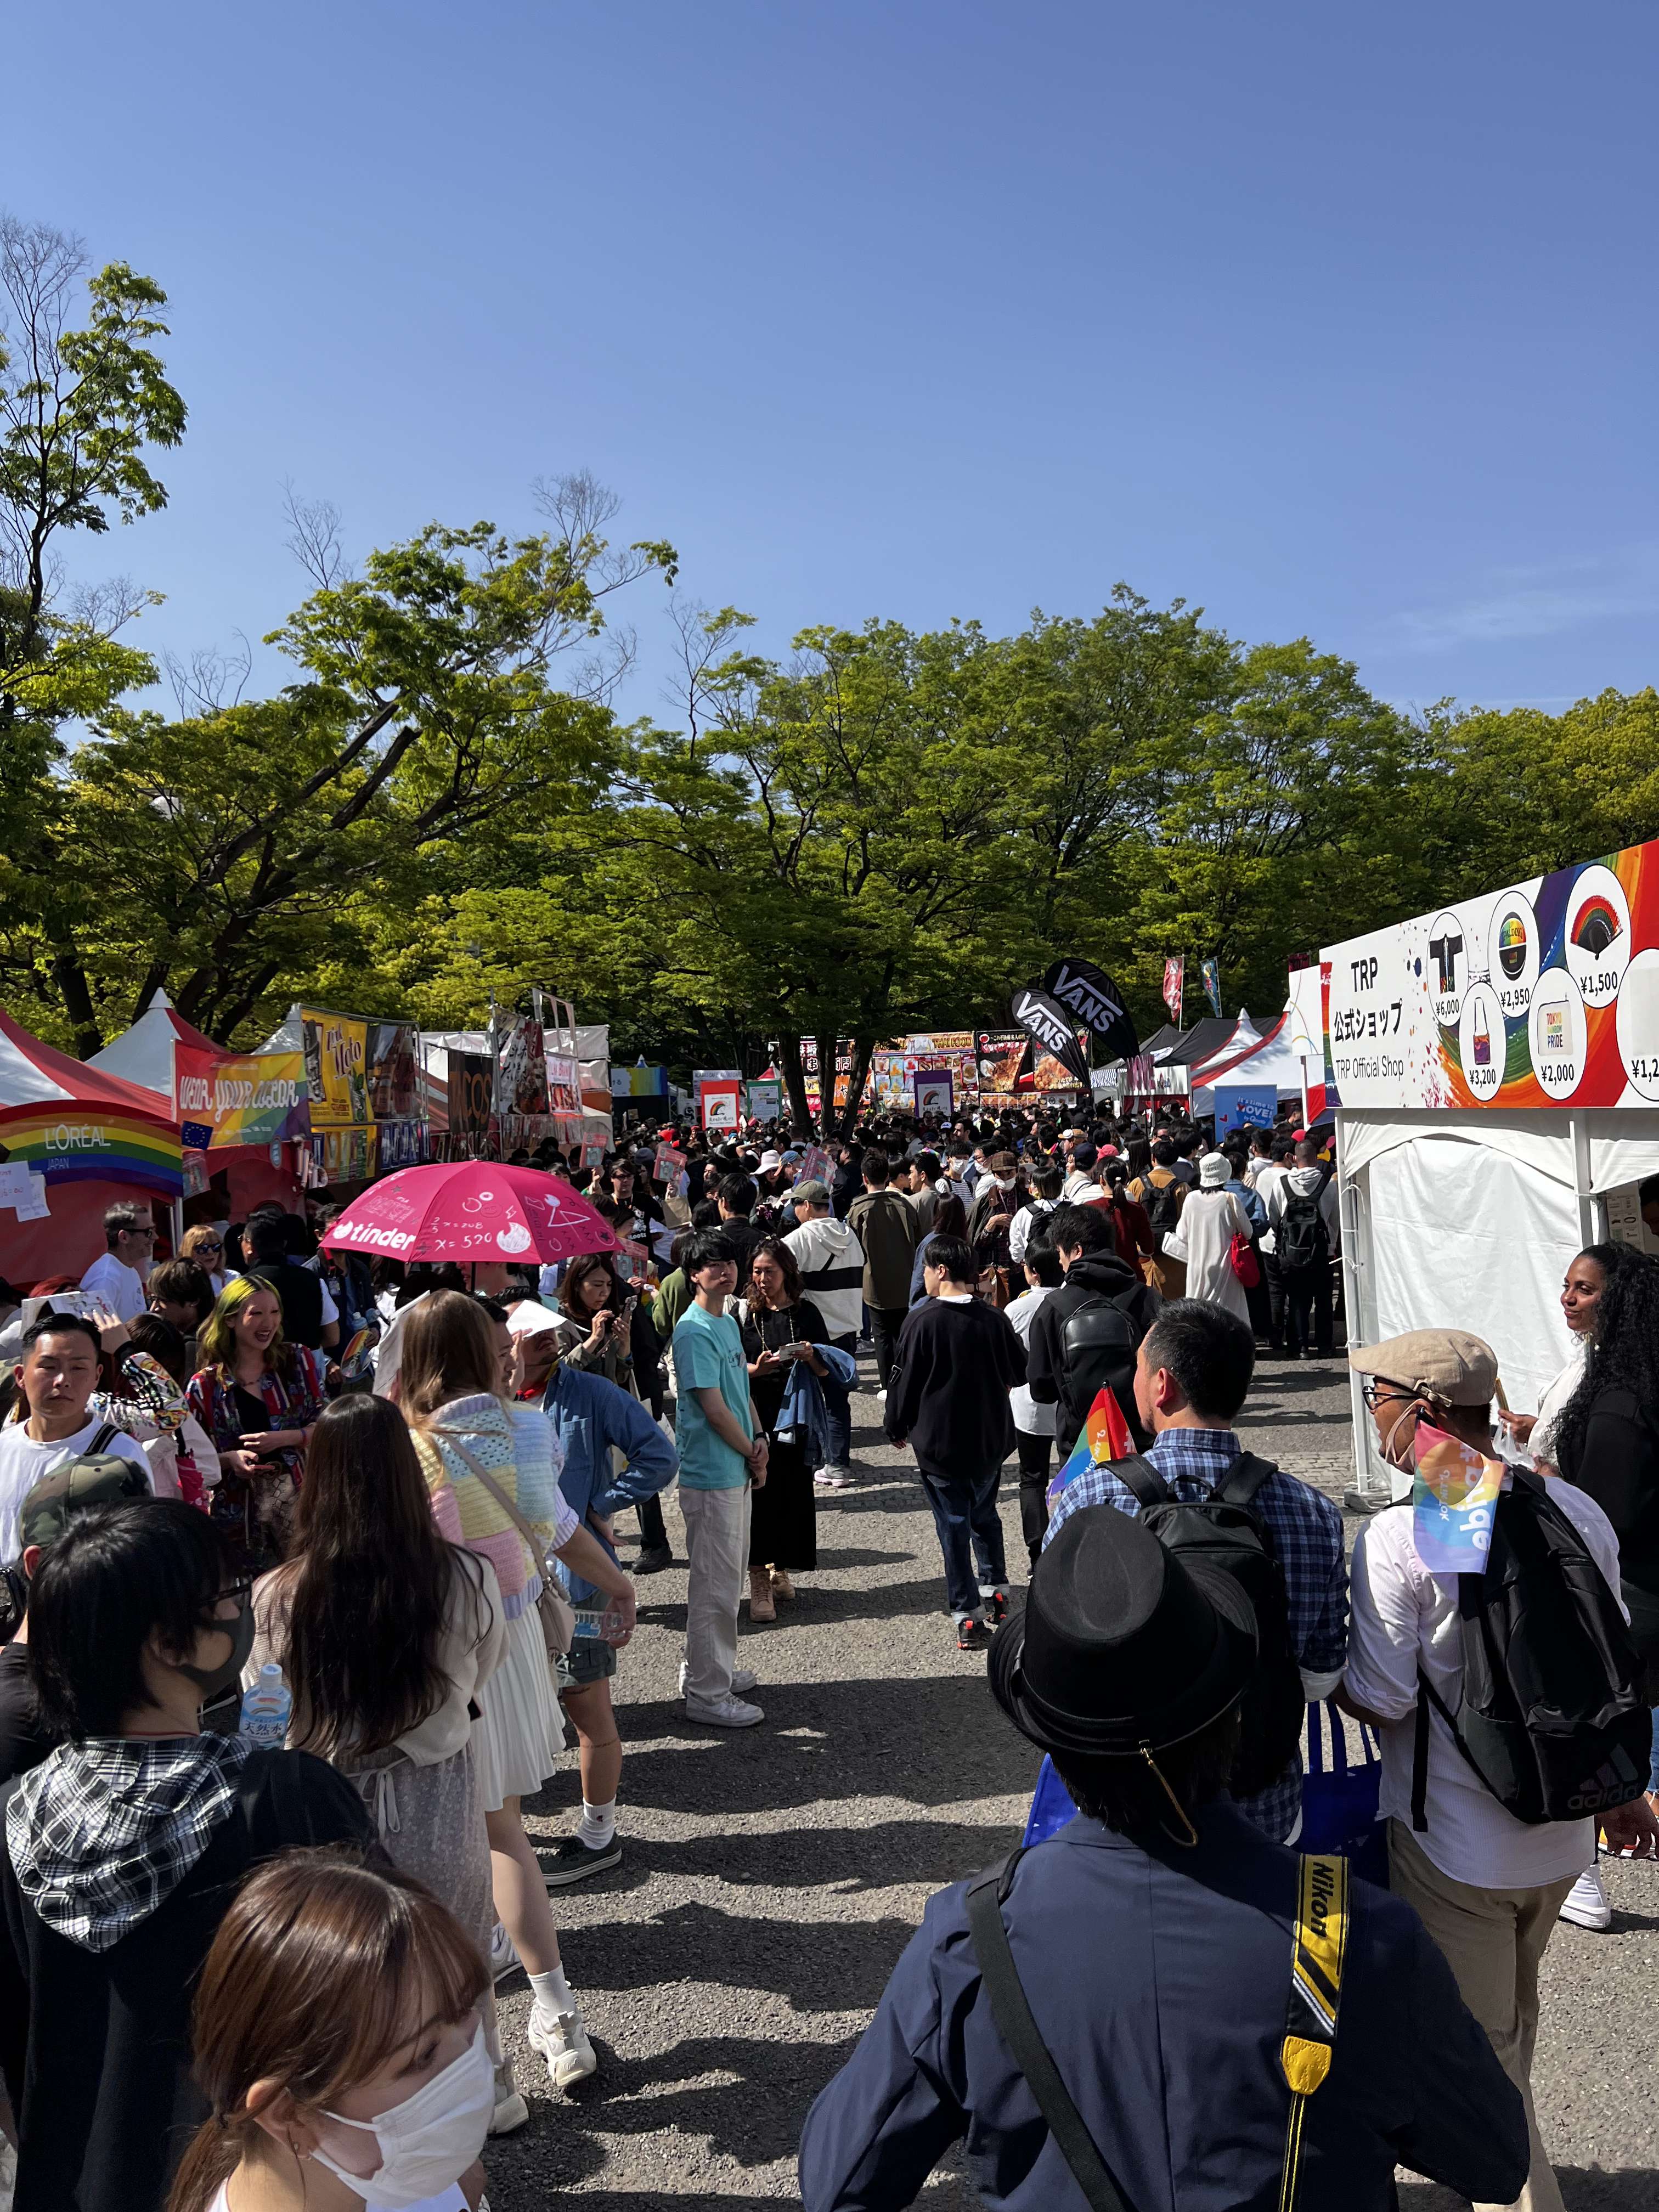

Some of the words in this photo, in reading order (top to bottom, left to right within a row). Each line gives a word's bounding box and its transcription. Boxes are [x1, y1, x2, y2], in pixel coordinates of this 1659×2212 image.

[1351, 956, 1378, 992] TRP
[1581, 971, 1618, 997] ¥1,500
[1053, 964, 1124, 1032] VANS
[1436, 998, 1459, 1018] ¥6,000
[1500, 988, 1530, 1010] ¥2,950
[1016, 992, 1074, 1052] VANS
[1334, 997, 1403, 1042] 公式ショップ
[1547, 1012, 1562, 1025] TOKYO
[933, 1038, 950, 1048] THAI
[951, 1037, 972, 1047] FOOD
[1547, 1034, 1563, 1048] PRIDE
[1336, 1058, 1350, 1079] TRP
[1353, 1056, 1379, 1078] Official
[1381, 1054, 1404, 1081] Shop
[1470, 1068, 1496, 1088] ¥3,200
[1541, 1063, 1574, 1086] ¥2,000
[1632, 1058, 1659, 1082] ¥1,2
[1236, 1103, 1273, 1119] MOVE!
[1250, 1099, 1266, 1107] time
[44, 1124, 111, 1150] L'ORÉAL
[47, 1158, 69, 1170] JAPAN
[350, 1222, 417, 1251] tinder
[461, 1232, 492, 1248] 520
[244, 1720, 282, 1735] 天然水
[1567, 1783, 1639, 1810] adida
[1311, 1861, 1335, 1938] Nikon
